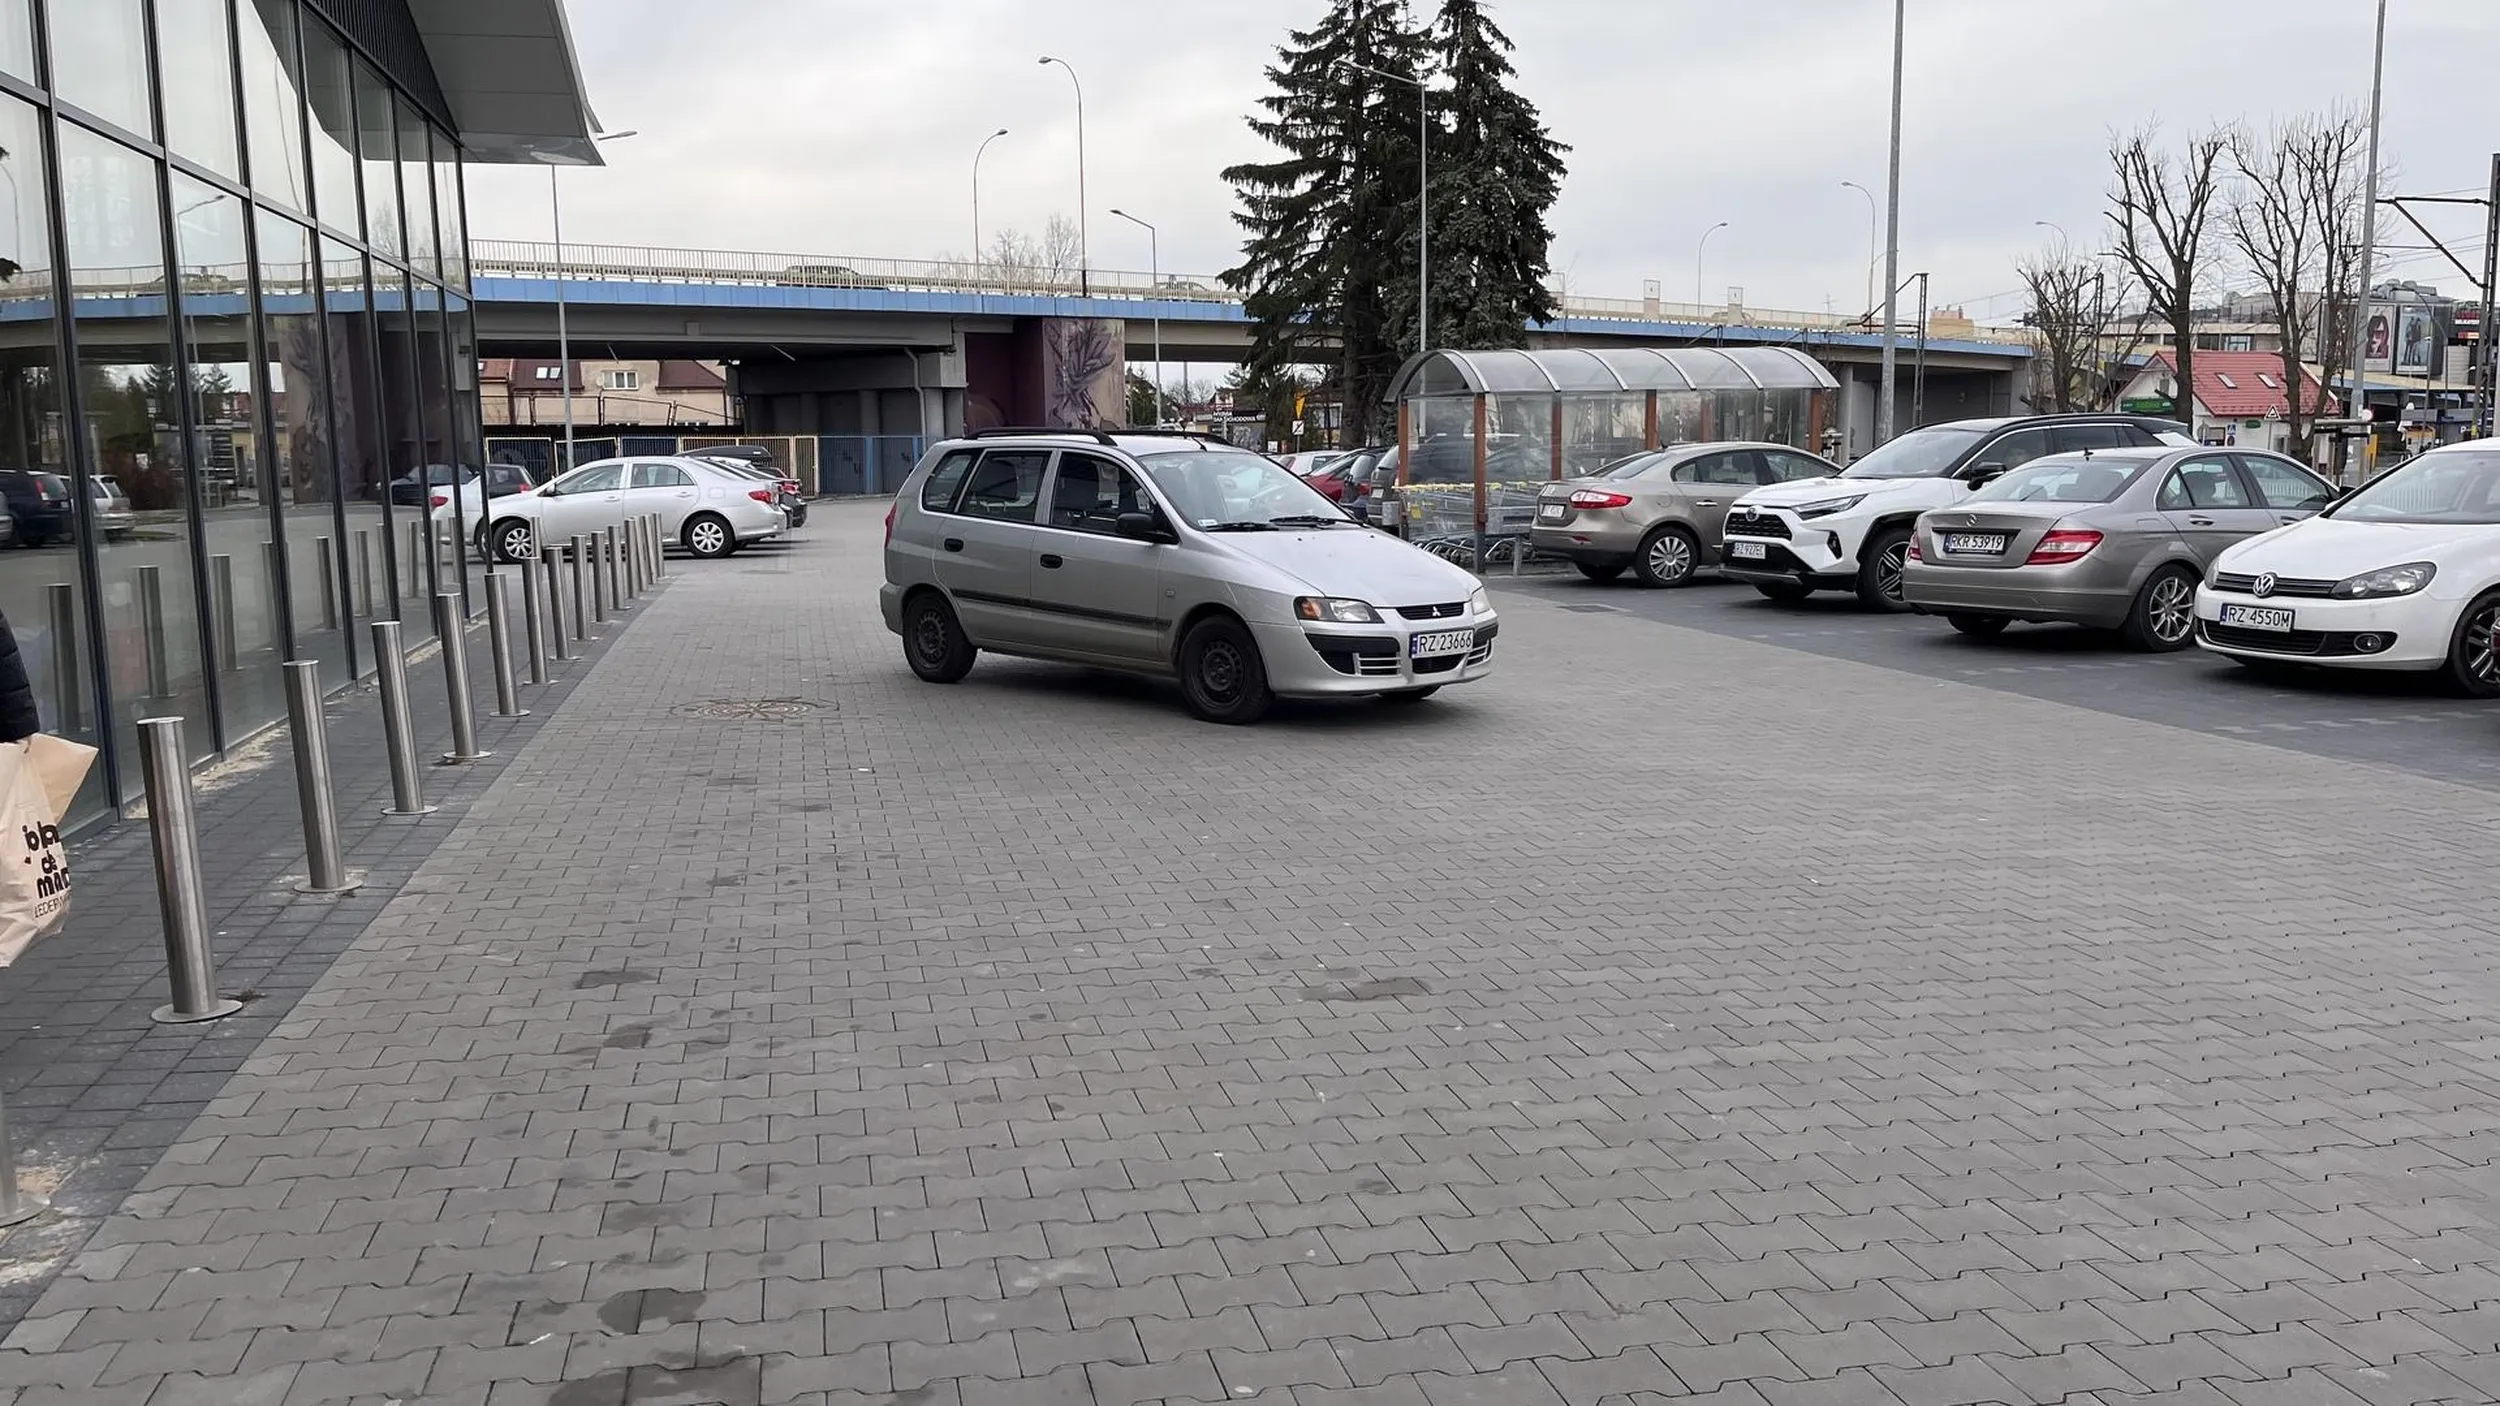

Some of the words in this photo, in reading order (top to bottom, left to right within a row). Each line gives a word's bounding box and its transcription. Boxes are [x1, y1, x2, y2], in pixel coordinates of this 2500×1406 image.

[1971, 535, 2003, 548] 53919
[2228, 607, 2246, 623] RZ
[2249, 610, 2291, 627] 4550M
[1419, 635, 1437, 653] RZ
[1440, 631, 1472, 651] 23666
